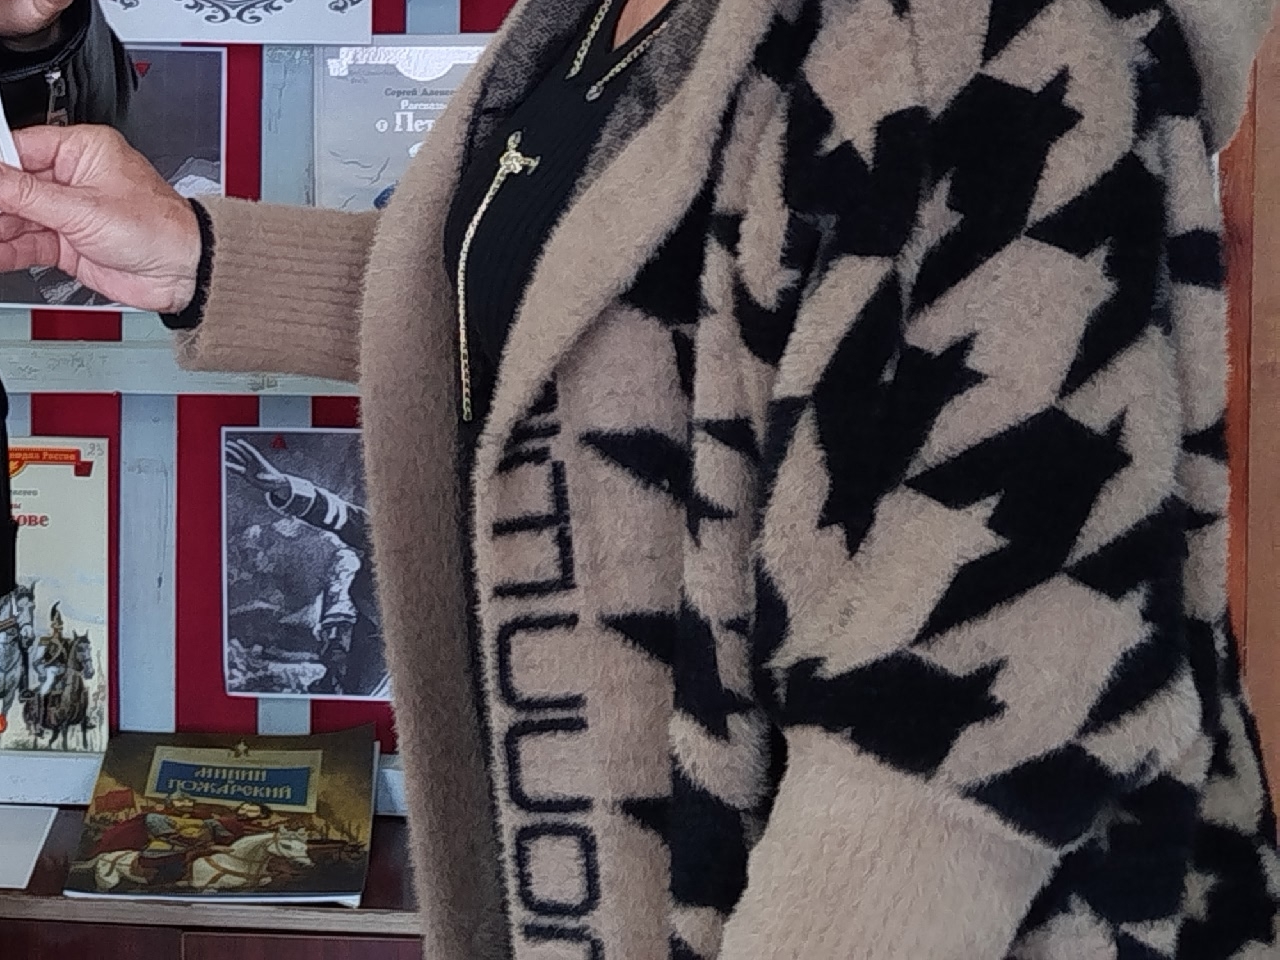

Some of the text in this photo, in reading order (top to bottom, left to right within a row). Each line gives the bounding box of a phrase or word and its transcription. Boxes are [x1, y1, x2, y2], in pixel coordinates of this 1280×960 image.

[384, 88, 418, 98] Сергей
[394, 111, 437, 132] Пет
[11, 514, 50, 528] ове
[195, 767, 267, 782] МИНИН
[167, 779, 292, 800] ПОЖАРСКИЙ
